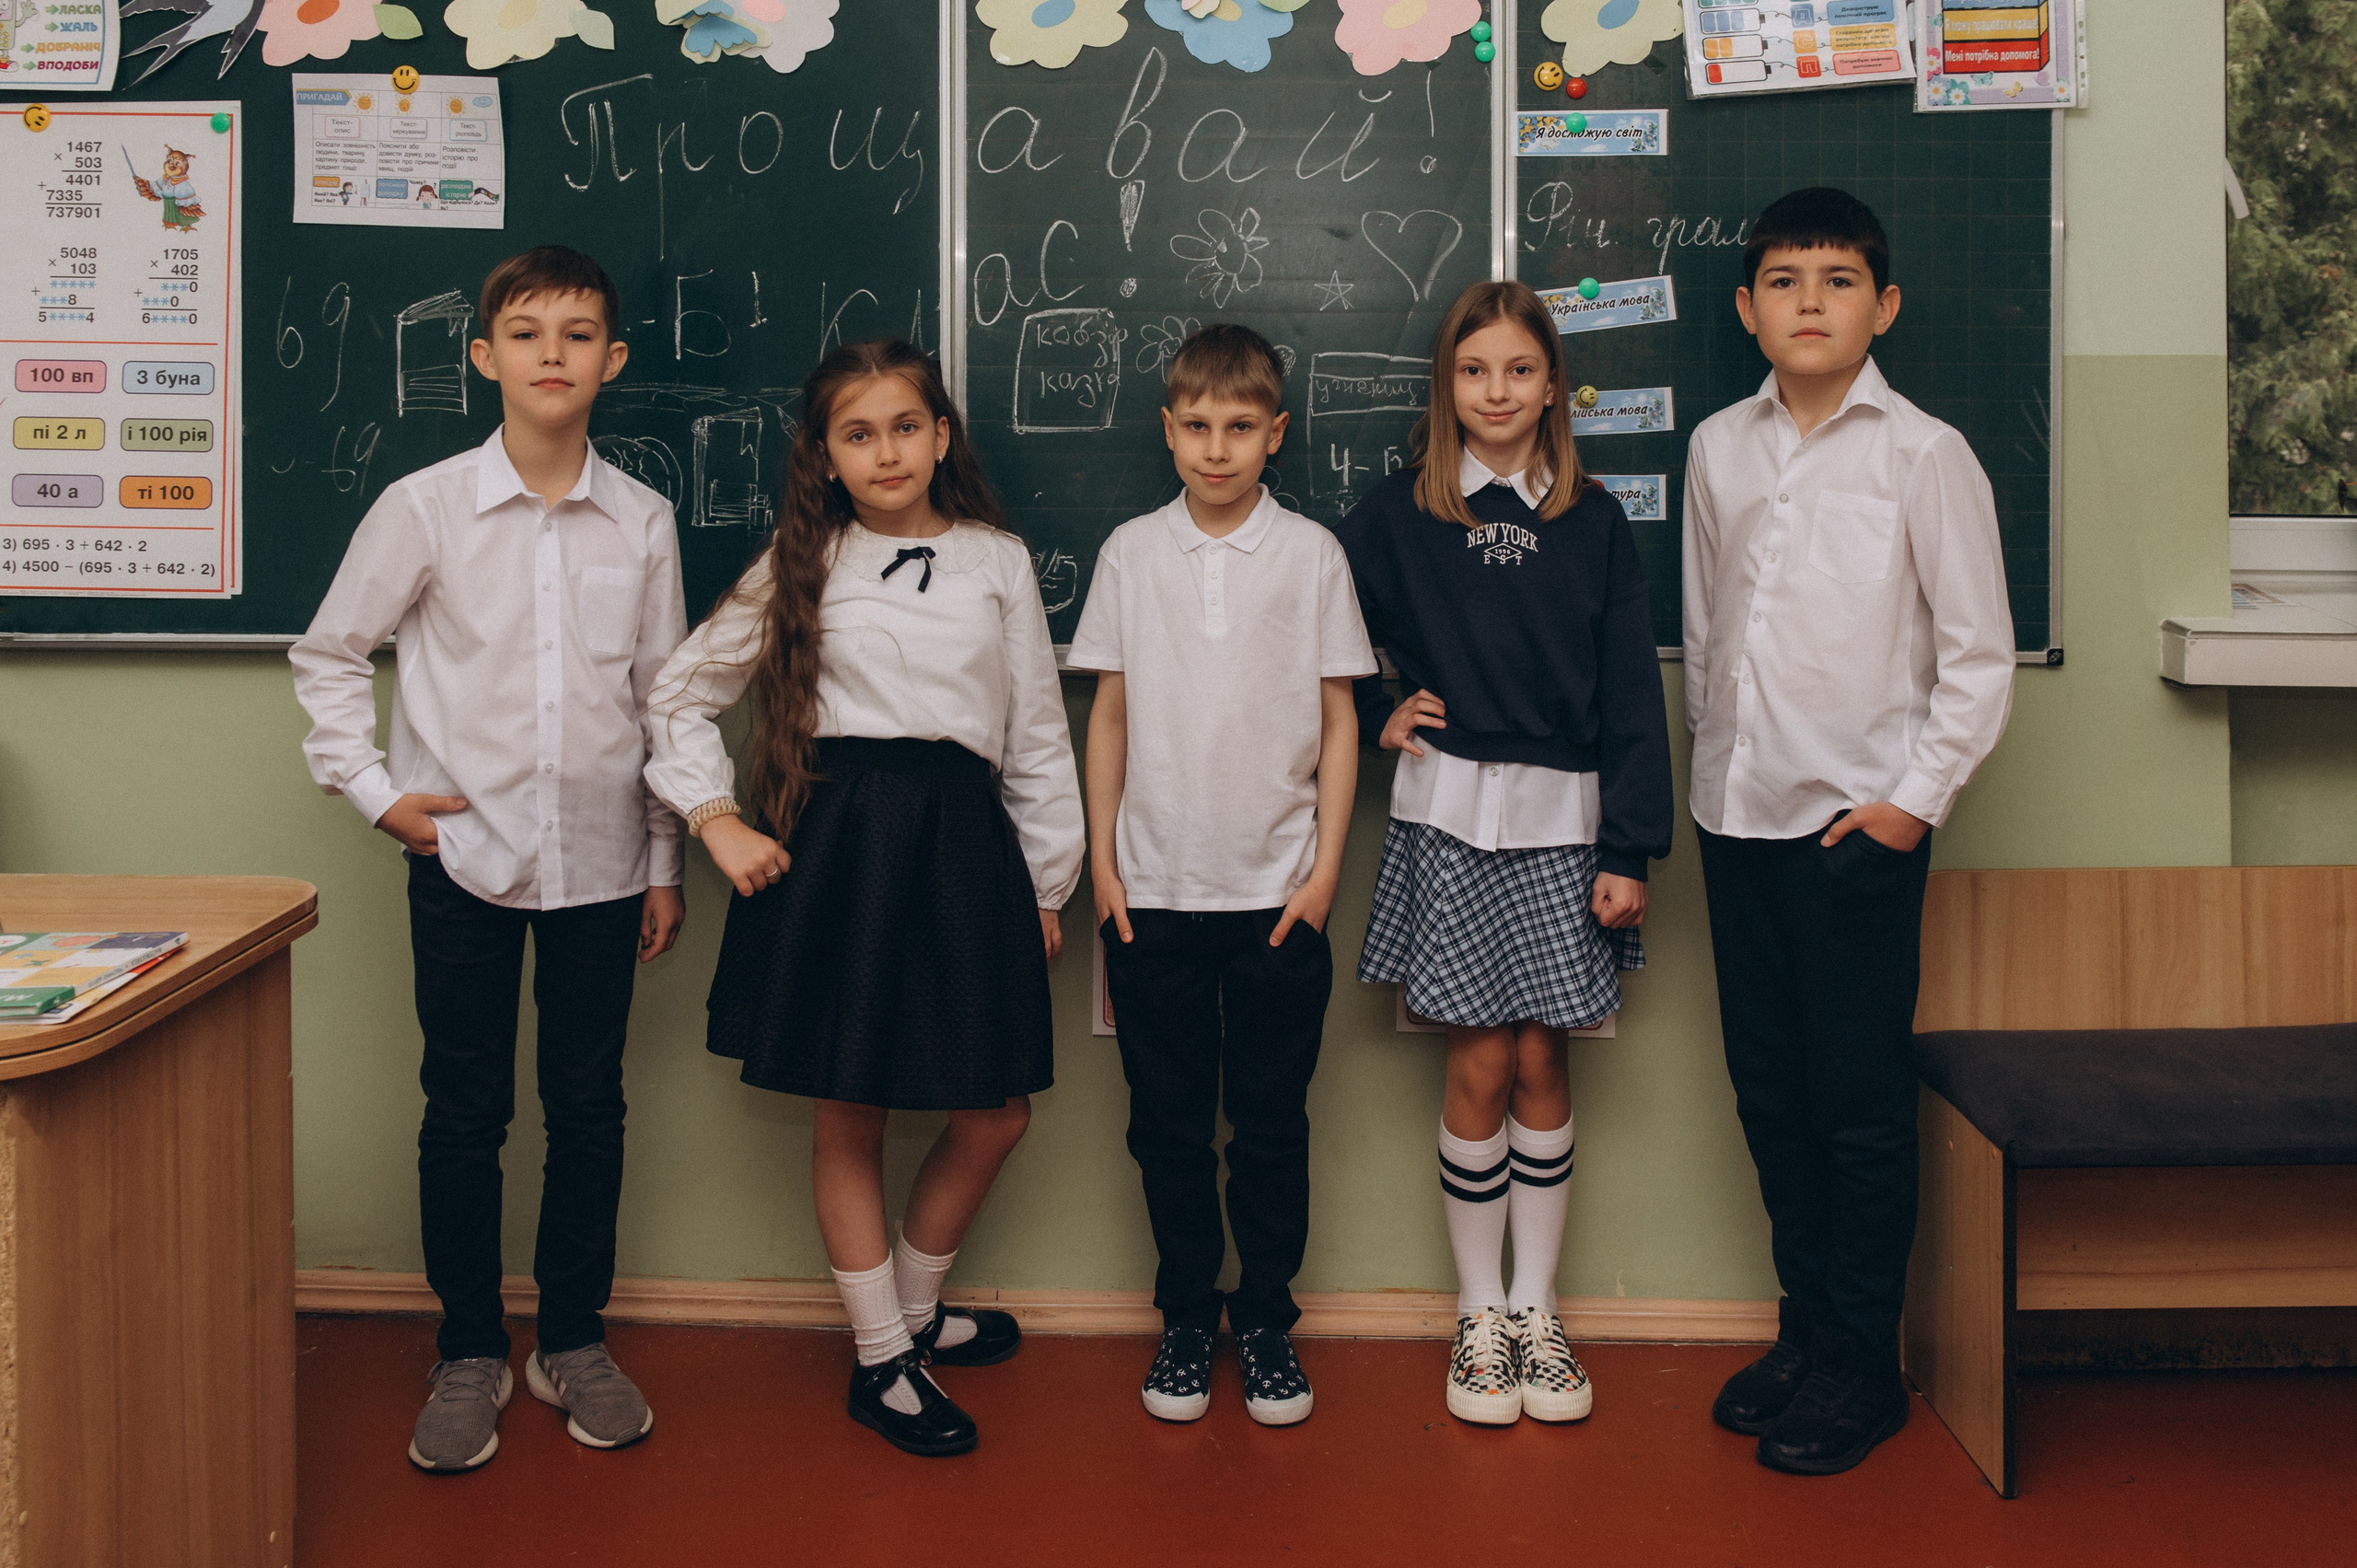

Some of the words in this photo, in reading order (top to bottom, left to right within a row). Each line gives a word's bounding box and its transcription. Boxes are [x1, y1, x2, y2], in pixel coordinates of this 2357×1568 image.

[58, 5, 102, 16] ЛАСКА
[59, 22, 99, 32] ЖАЛЬ
[35, 41, 101, 54] ДОБРАНІЧ
[1945, 50, 1964, 63] Мені
[1965, 49, 1999, 64] потрібна
[2000, 47, 2040, 63] допомога!
[37, 61, 99, 72] ВПОДОБИ
[296, 93, 343, 102] ПРИГАДАЙ
[1536, 127, 1546, 139] Я
[1615, 125, 1643, 138] світ
[66, 141, 102, 153] 1467
[75, 157, 102, 168] 503
[65, 174, 101, 186] 4401
[46, 190, 84, 202] 7335
[46, 206, 101, 219] 737901
[60, 248, 98, 260] 5048
[163, 249, 199, 260] 1705
[70, 263, 97, 275] 103
[170, 265, 199, 276] 402
[1550, 299, 1617, 317] Українська
[1619, 295, 1651, 308] мова
[30, 368, 65, 384] 100
[72, 372, 95, 383] вп
[137, 371, 149, 385] 3
[155, 370, 201, 389] буна
[1617, 405, 1649, 416] мова
[33, 425, 50, 439] пі
[56, 425, 68, 440] 2
[75, 429, 87, 440] л
[127, 426, 133, 440] і
[139, 426, 174, 441] 100
[179, 427, 208, 445] рія
[37, 483, 62, 499] 40
[68, 487, 79, 498] а
[137, 485, 154, 500] ті
[159, 485, 194, 500] 100
[1467, 522, 1499, 549] NEW
[1499, 522, 1538, 552] YORK
[2, 539, 17, 552] 3)
[22, 539, 51, 551] 695
[65, 540, 75, 551] 3
[94, 540, 123, 552] 642
[137, 540, 147, 552] 2
[2, 560, 17, 574] 4)
[22, 560, 60, 572] 4500
[127, 563, 137, 574] 3
[157, 563, 186, 575] 642
[201, 563, 215, 577] 2)
